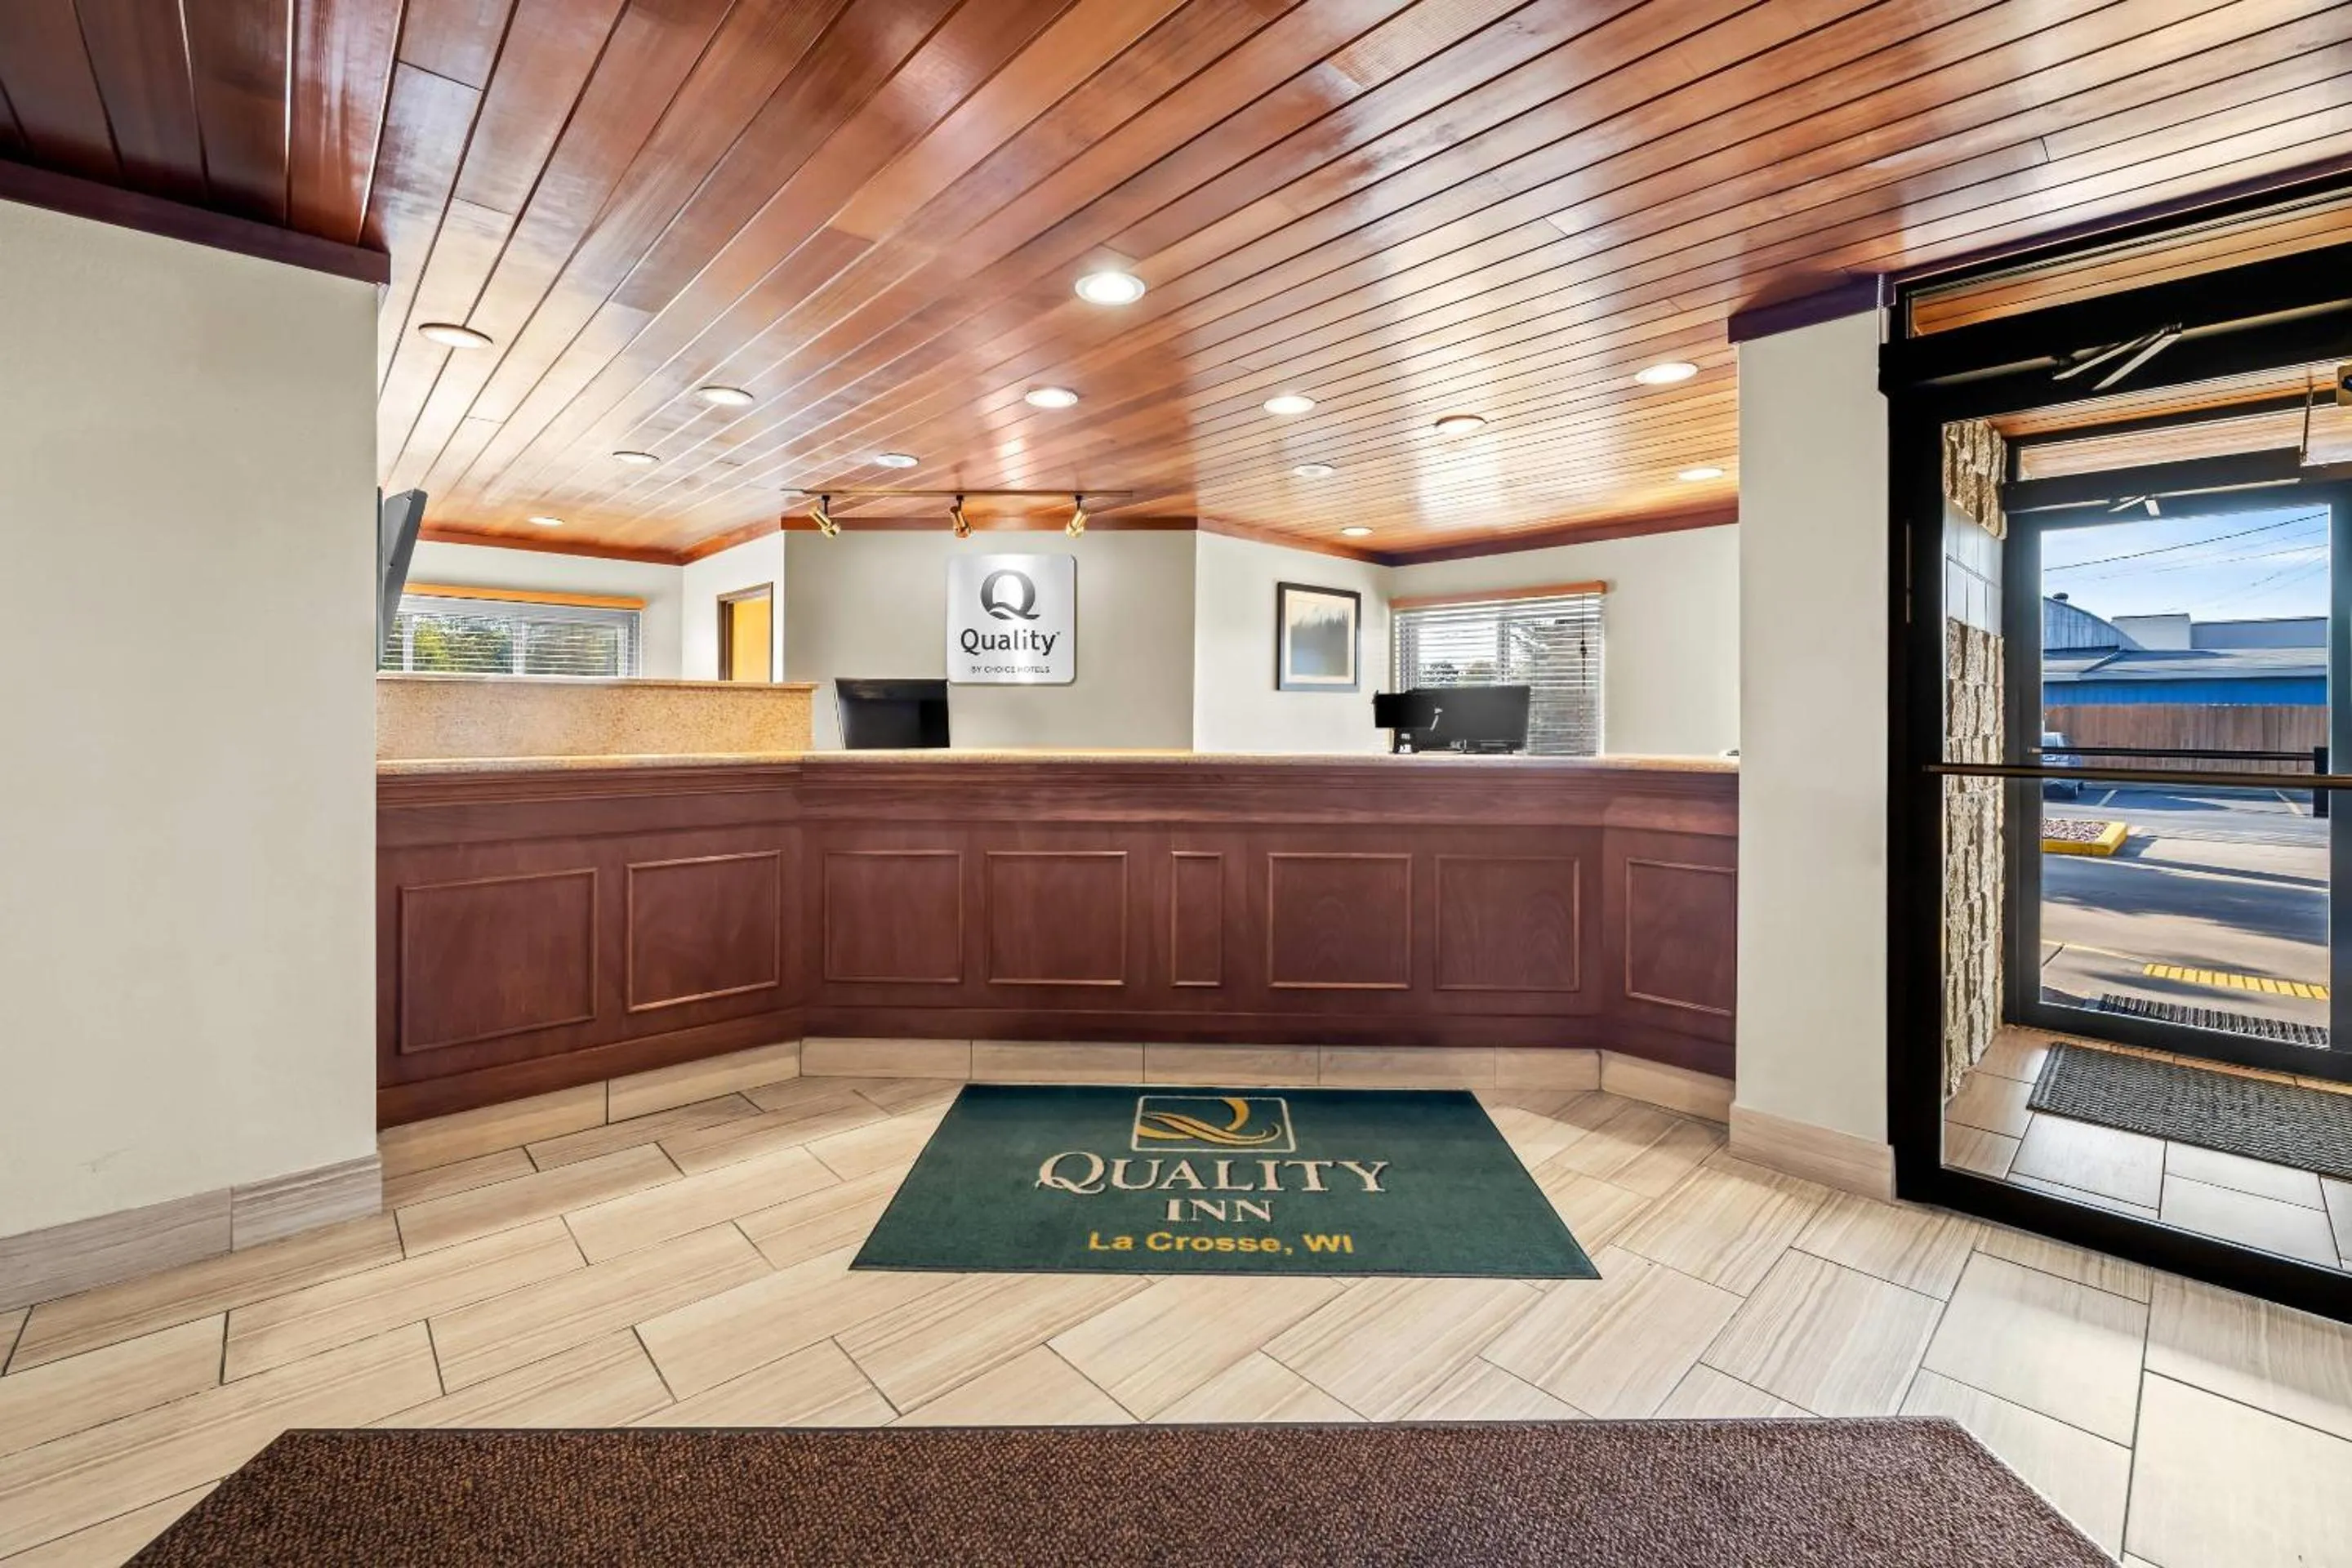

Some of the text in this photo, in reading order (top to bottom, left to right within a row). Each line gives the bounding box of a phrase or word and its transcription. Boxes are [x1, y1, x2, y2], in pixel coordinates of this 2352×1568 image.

[960, 628, 1057, 656] Quality
[971, 666, 1050, 674] BY CHOICE HOTELS
[1035, 1152, 1388, 1195] QUALITY
[1163, 1199, 1273, 1223] INN
[1089, 1231, 1355, 1256] La Crosse, WI
